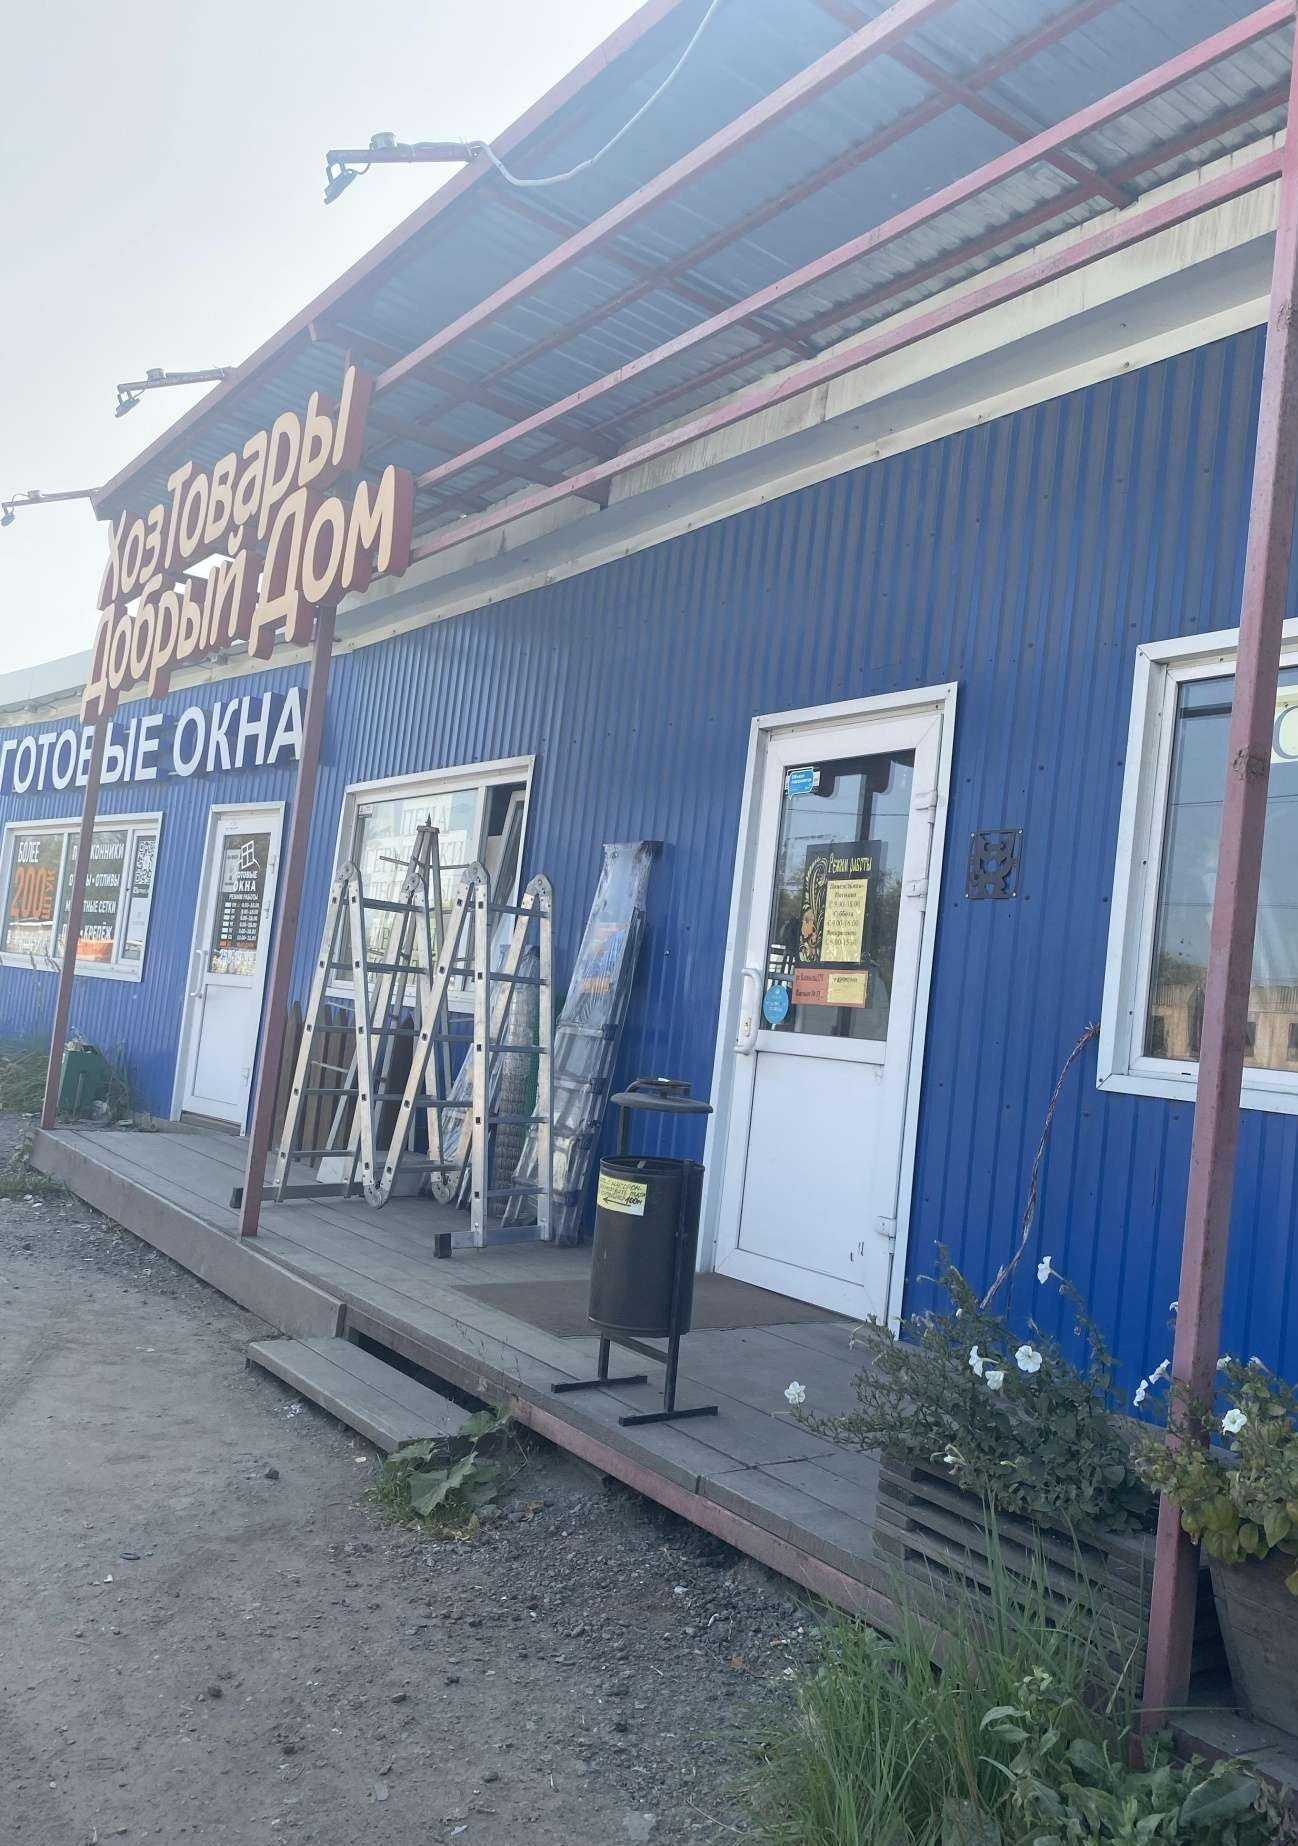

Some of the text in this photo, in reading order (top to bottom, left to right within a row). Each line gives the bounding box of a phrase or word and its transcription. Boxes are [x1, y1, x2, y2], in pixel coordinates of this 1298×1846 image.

[80, 464, 396, 723] Добрый Дом
[0, 686, 304, 794] ГОТОВЫЕ ОКНА
[18, 841, 41, 863] БОЛЕЕ
[72, 842, 125, 862] ПКОННИКИ
[95, 873, 121, 888] ОТЛИВЫ
[233, 880, 256, 892] ОКНА
[10, 865, 47, 919] 200
